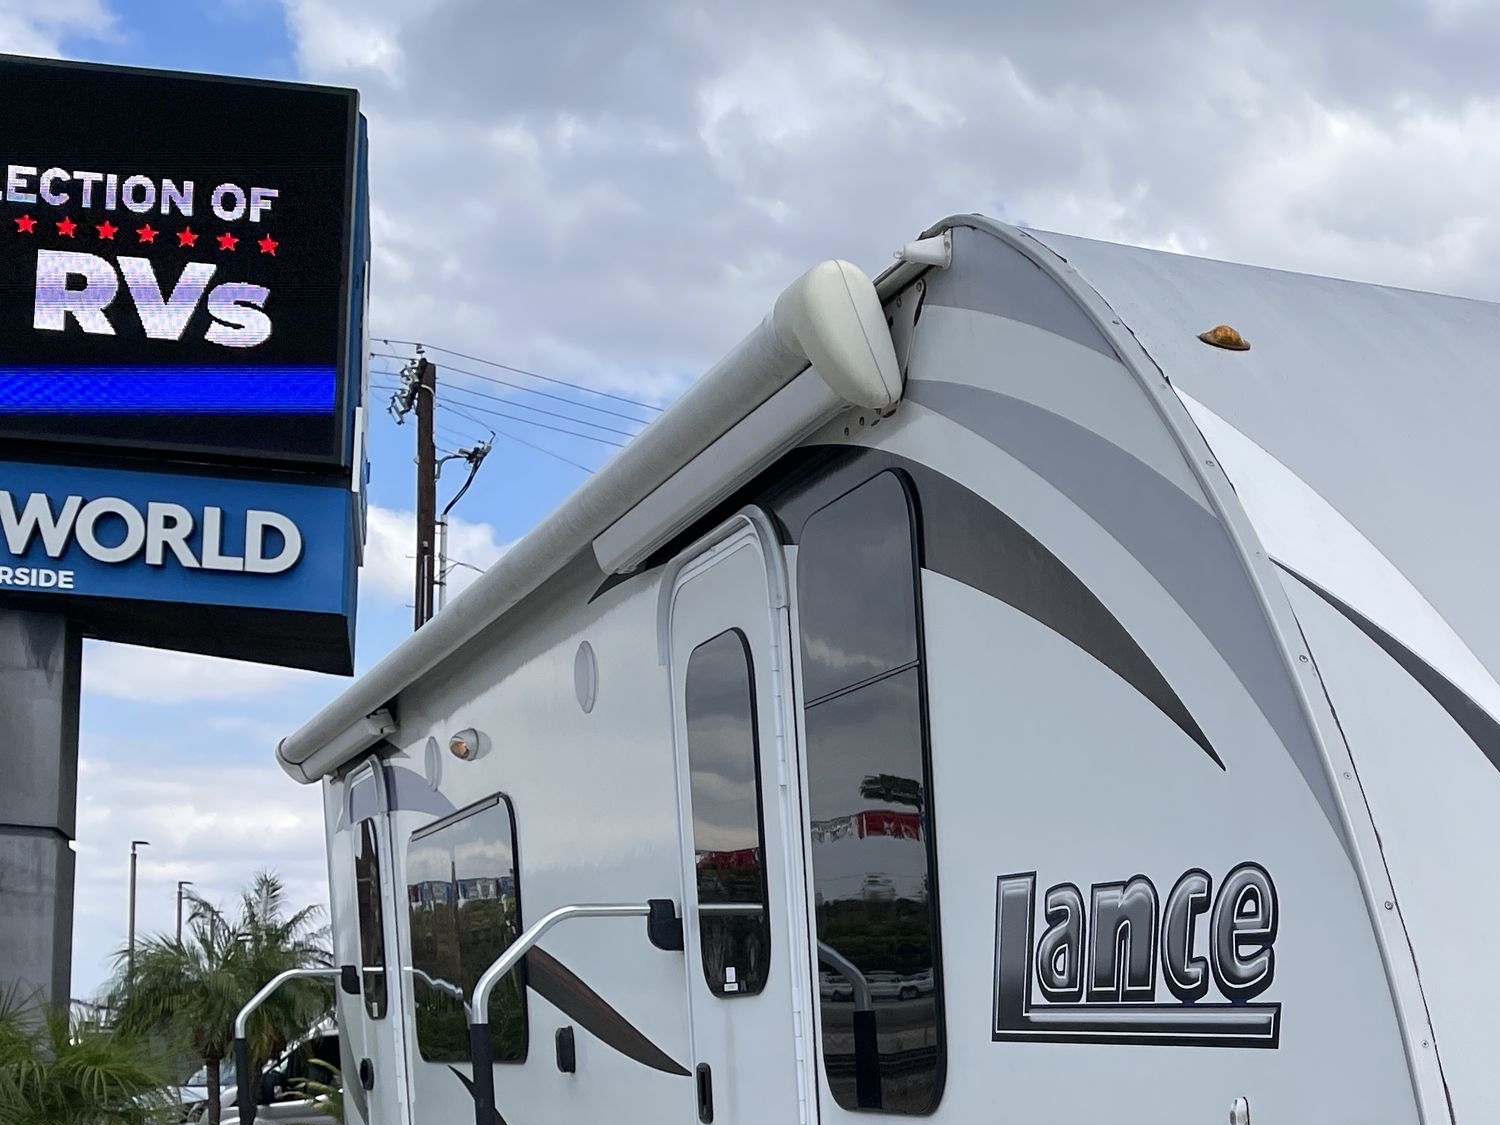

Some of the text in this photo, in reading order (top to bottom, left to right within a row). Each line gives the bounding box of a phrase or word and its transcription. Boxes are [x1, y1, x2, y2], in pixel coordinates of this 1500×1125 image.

[0, 164, 279, 222] ECTION OF
[33, 248, 273, 348] RVs
[0, 490, 302, 575] WORLD
[992, 861, 1281, 1049] Lance
